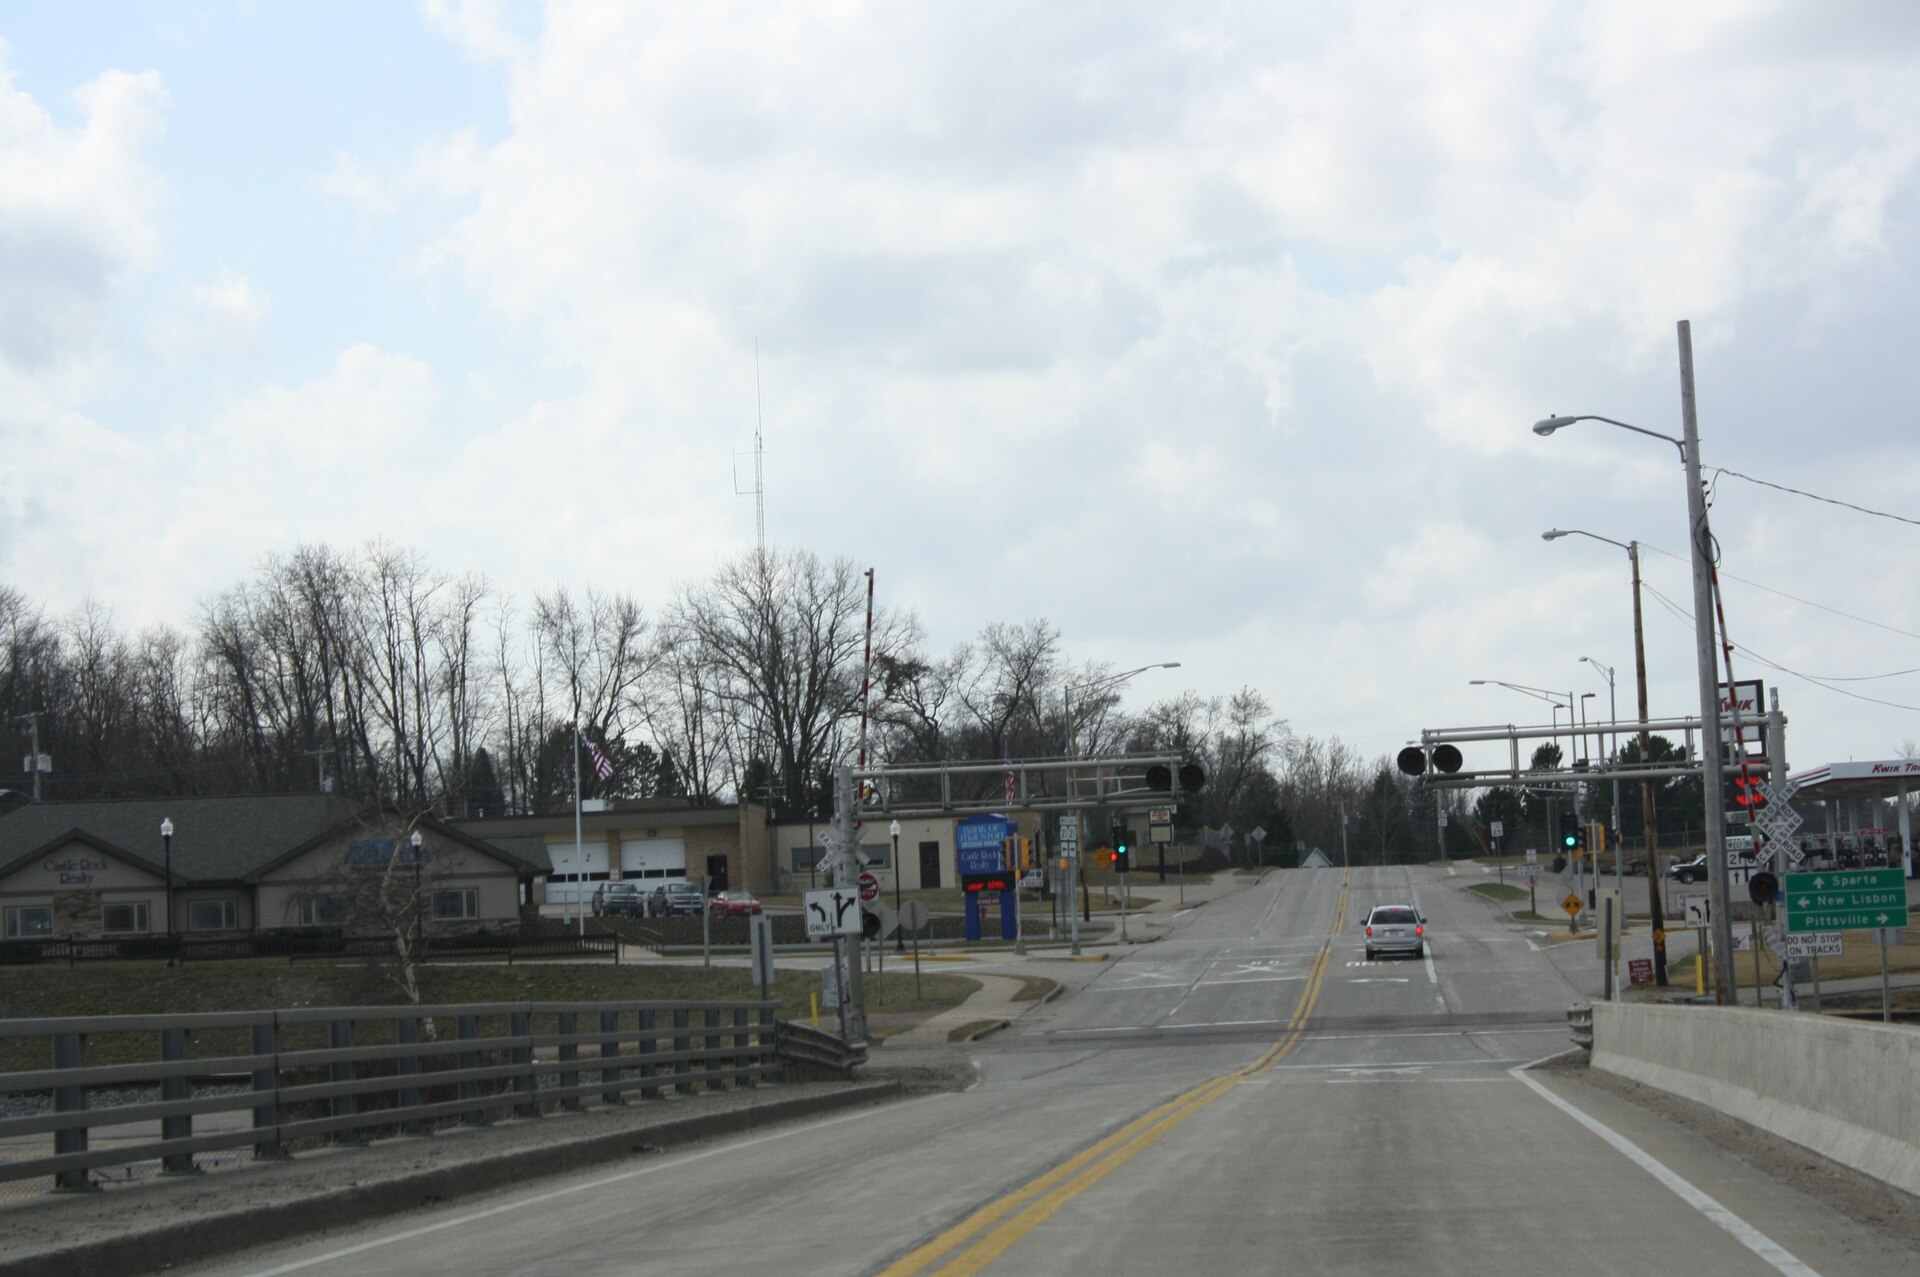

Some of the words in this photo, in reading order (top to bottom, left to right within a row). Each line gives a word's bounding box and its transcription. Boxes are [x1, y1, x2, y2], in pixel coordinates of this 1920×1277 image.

[1762, 781, 1799, 818] ROSSING
[1757, 818, 1775, 837] RAIL
[1782, 841, 1802, 862] ROAD
[44, 859, 78, 872] Castle
[80, 858, 108, 871] Rock
[60, 872, 92, 888] Realty
[1832, 876, 1877, 887] Sparta
[1817, 896, 1845, 906] New
[1852, 893, 1897, 905] Lisbon
[1806, 915, 1869, 927] Pittsville
[810, 924, 830, 932] ONLY
[1787, 937, 1798, 945] DO
[1801, 935, 1817, 944] NOT
[1820, 935, 1841, 943] STOP
[1789, 947, 1801, 955] ON
[1806, 945, 1841, 954] TRACKS
